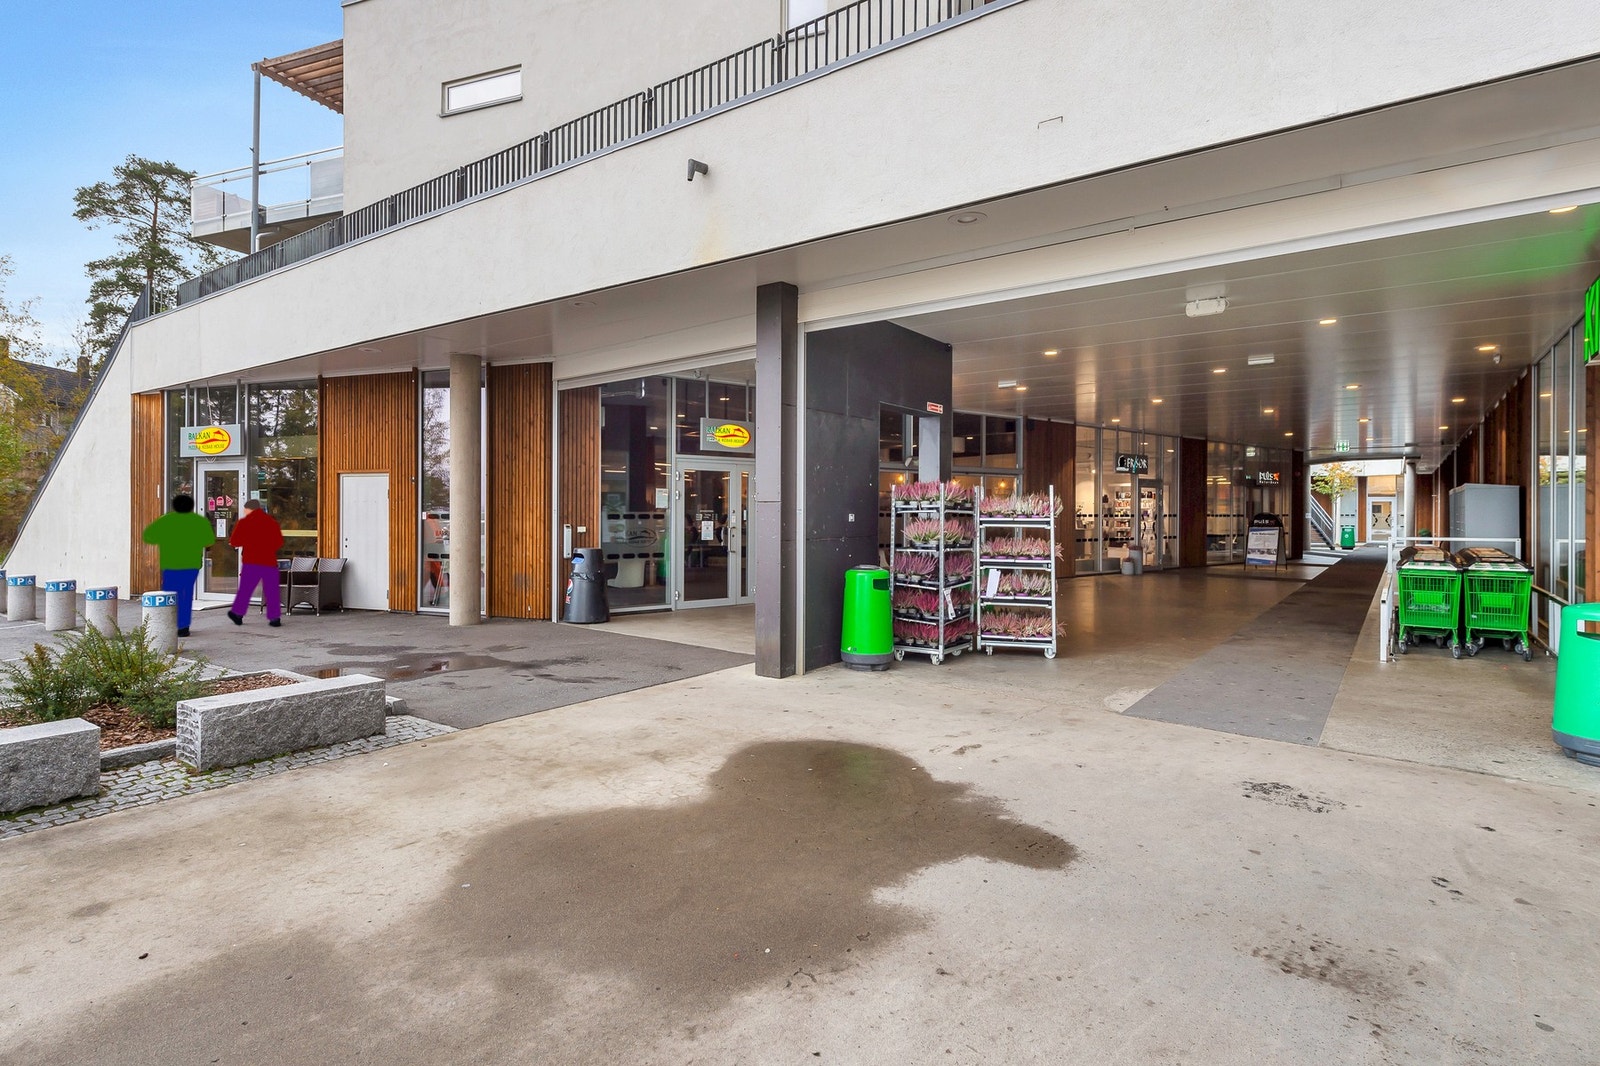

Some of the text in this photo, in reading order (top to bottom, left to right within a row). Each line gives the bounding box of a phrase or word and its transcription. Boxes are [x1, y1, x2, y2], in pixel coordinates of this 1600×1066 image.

[706, 426, 731, 434] BALKAN
[188, 431, 211, 440] BALKAN
[17, 577, 24, 585] P
[59, 582, 67, 591] P
[96, 590, 104, 599] P
[155, 596, 165, 606] P
